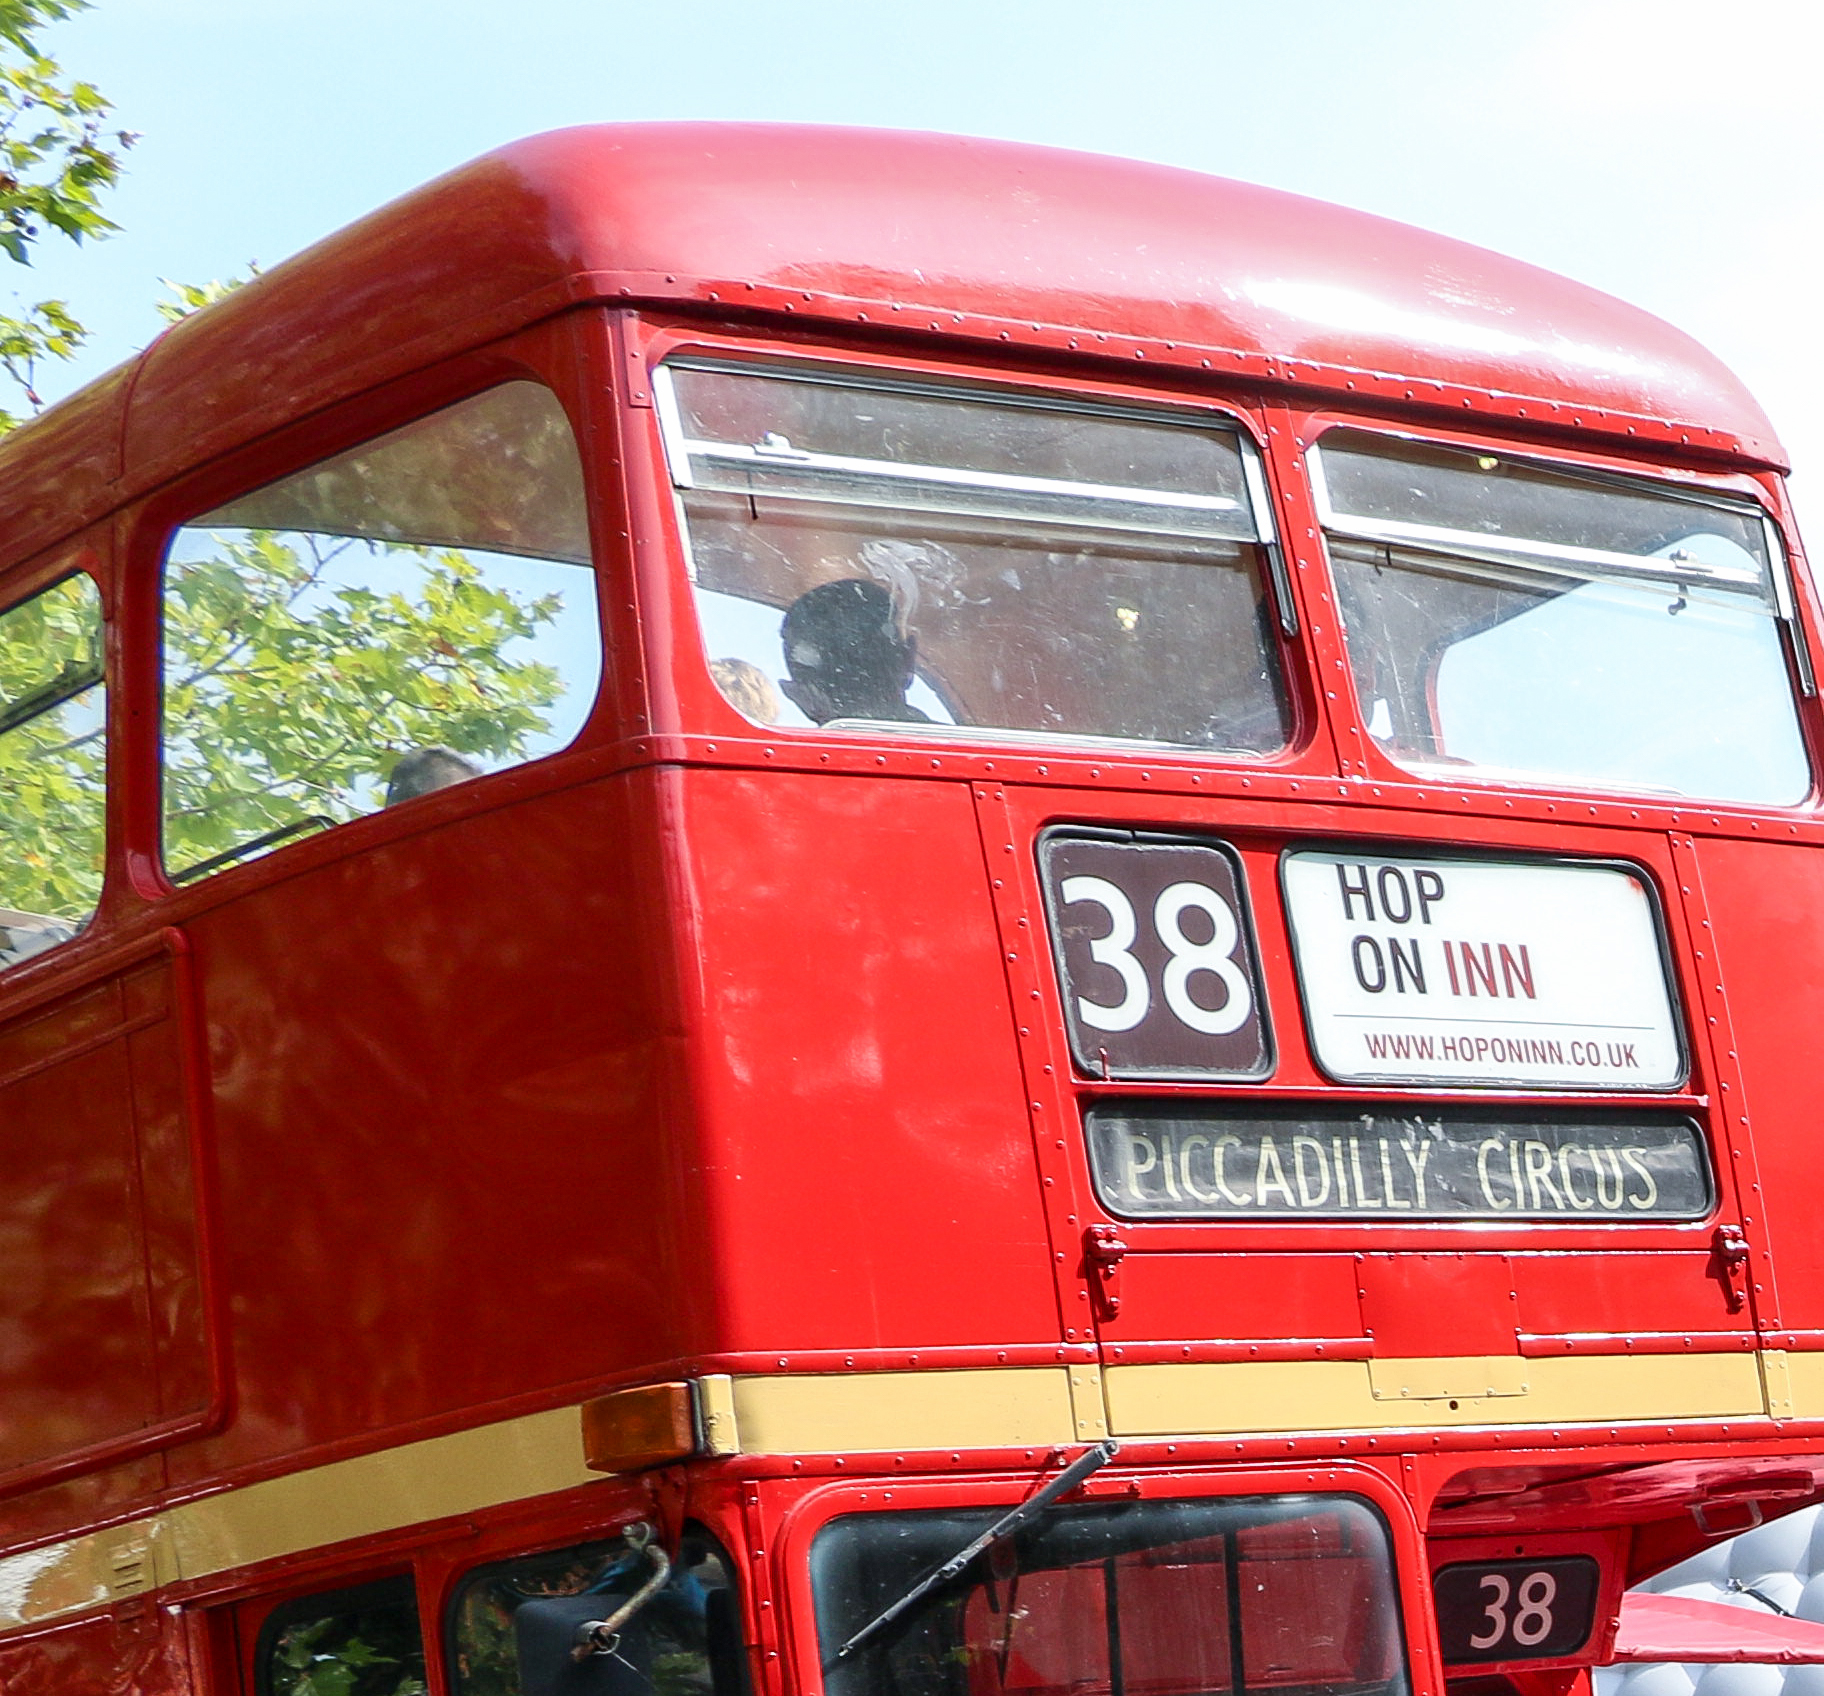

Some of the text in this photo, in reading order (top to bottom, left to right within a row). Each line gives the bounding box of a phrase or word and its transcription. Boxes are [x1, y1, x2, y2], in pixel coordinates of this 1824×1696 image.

[1337, 863, 1445, 926] HOP
[1060, 876, 1255, 1035] 38
[1351, 934, 1537, 1001] ON INN
[1365, 1031, 1640, 1069] WWW.HOPONINN.CO.UK
[1125, 1132, 1658, 1211] PICCADILLY CIRCUS
[1470, 1571, 1556, 1649] 38
